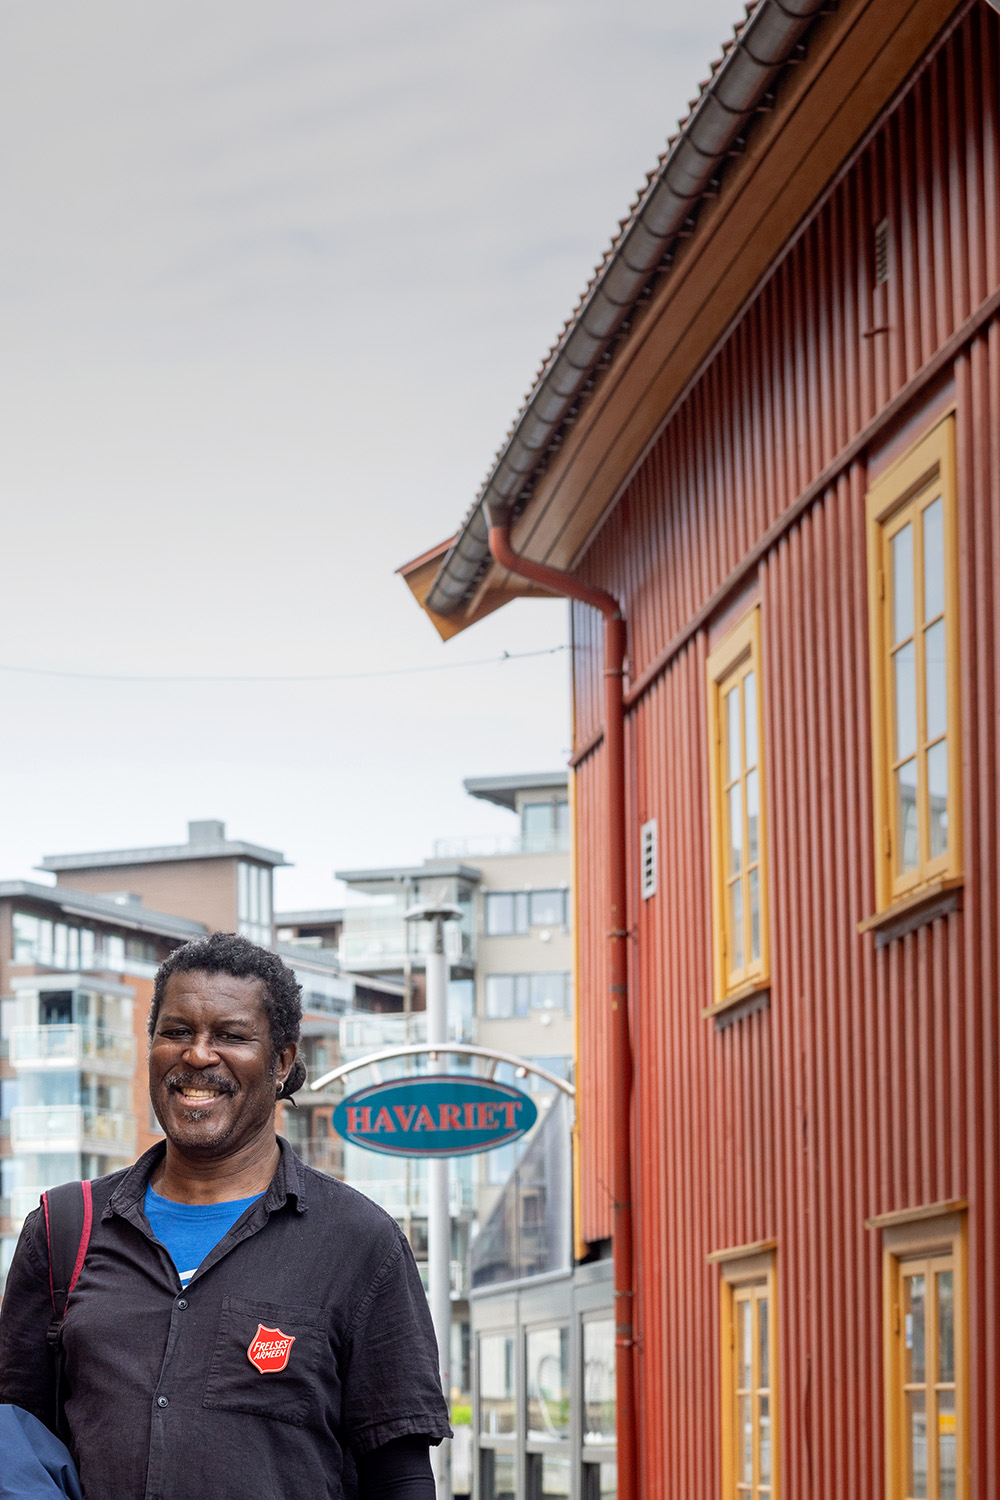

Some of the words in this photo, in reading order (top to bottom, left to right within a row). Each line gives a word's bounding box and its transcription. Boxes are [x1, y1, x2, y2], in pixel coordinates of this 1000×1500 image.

[345, 1101, 522, 1133] HAVARIET
[253, 1340, 289, 1352] FRELSES
[253, 1349, 287, 1360] ARMEEN
